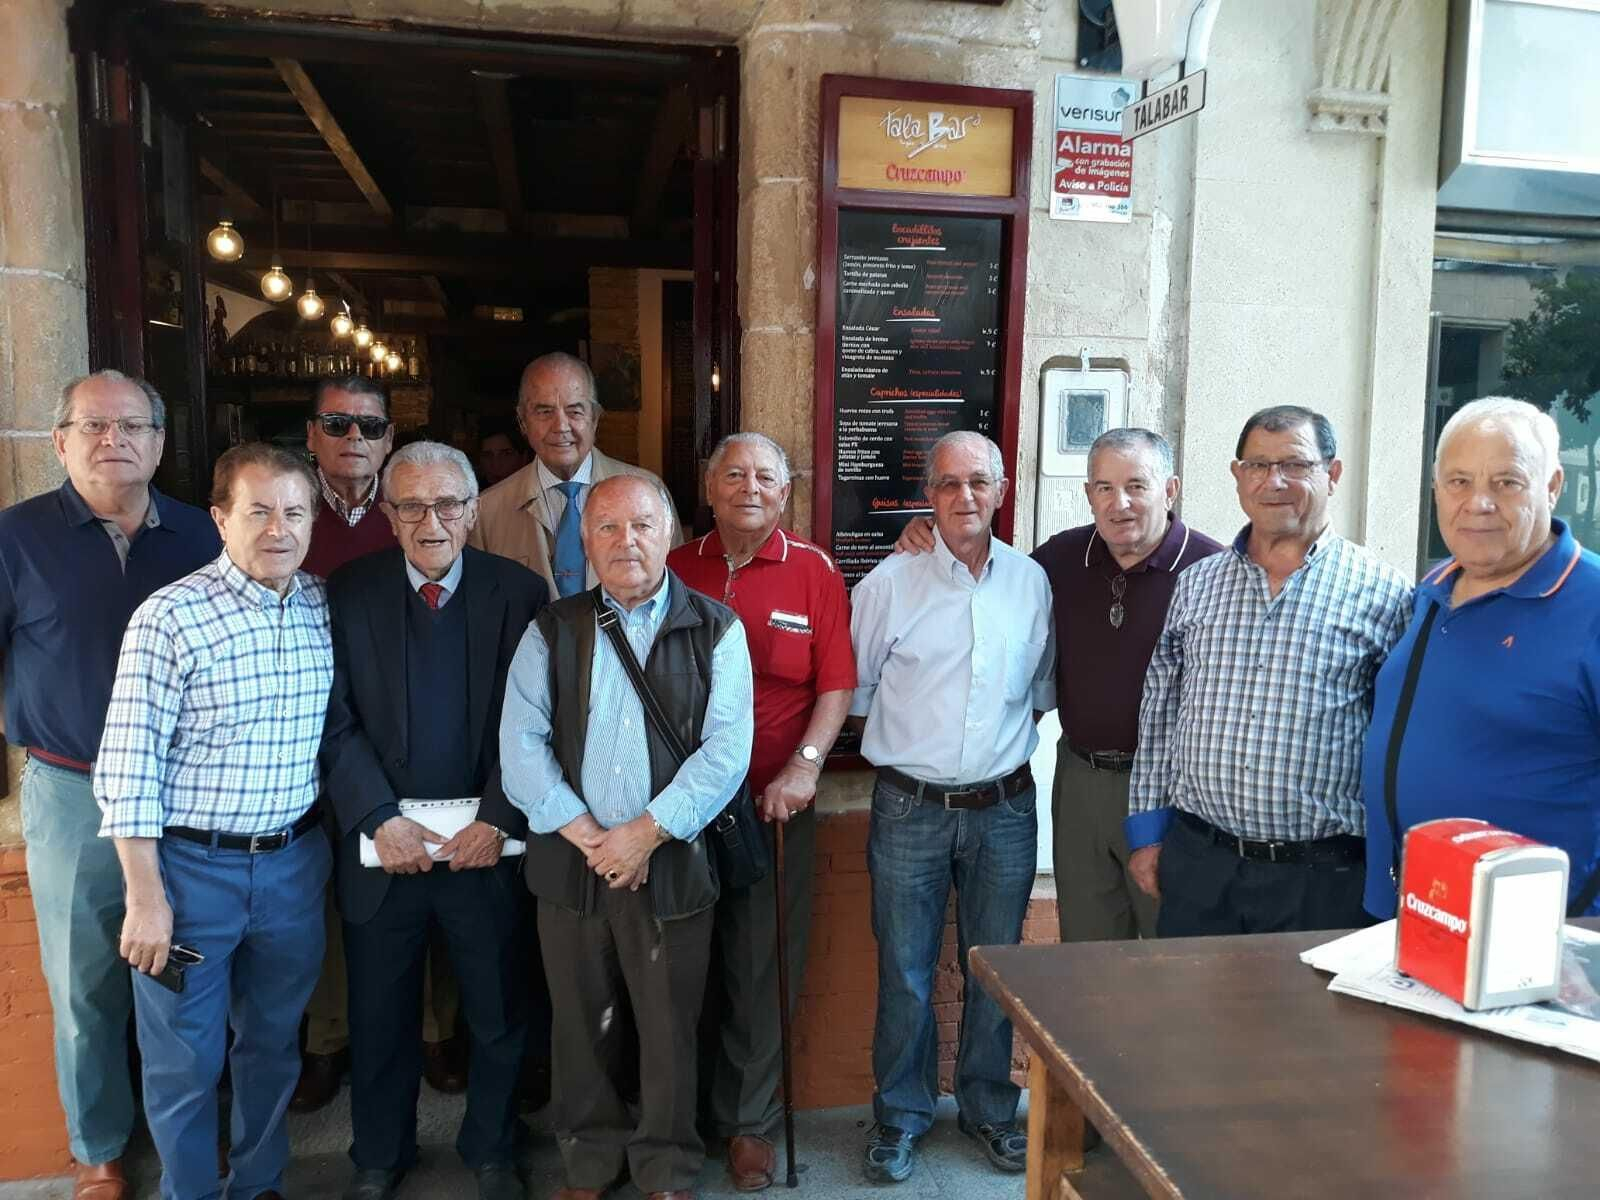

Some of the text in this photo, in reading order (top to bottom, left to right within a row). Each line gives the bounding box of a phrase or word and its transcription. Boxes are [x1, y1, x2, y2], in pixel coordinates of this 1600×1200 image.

[1060, 105, 1121, 123] verisur
[1134, 84, 1189, 132] TALABAR
[1059, 135, 1131, 157] Alarma
[1074, 165, 1130, 179] de imágenes
[1075, 158, 1130, 169] con grabación
[885, 163, 963, 187] Cruzcampo
[1058, 178, 1129, 193] Aviso a Policía
[893, 306, 936, 317] Ensaladas
[1407, 891, 1466, 933] Cruzcampo
